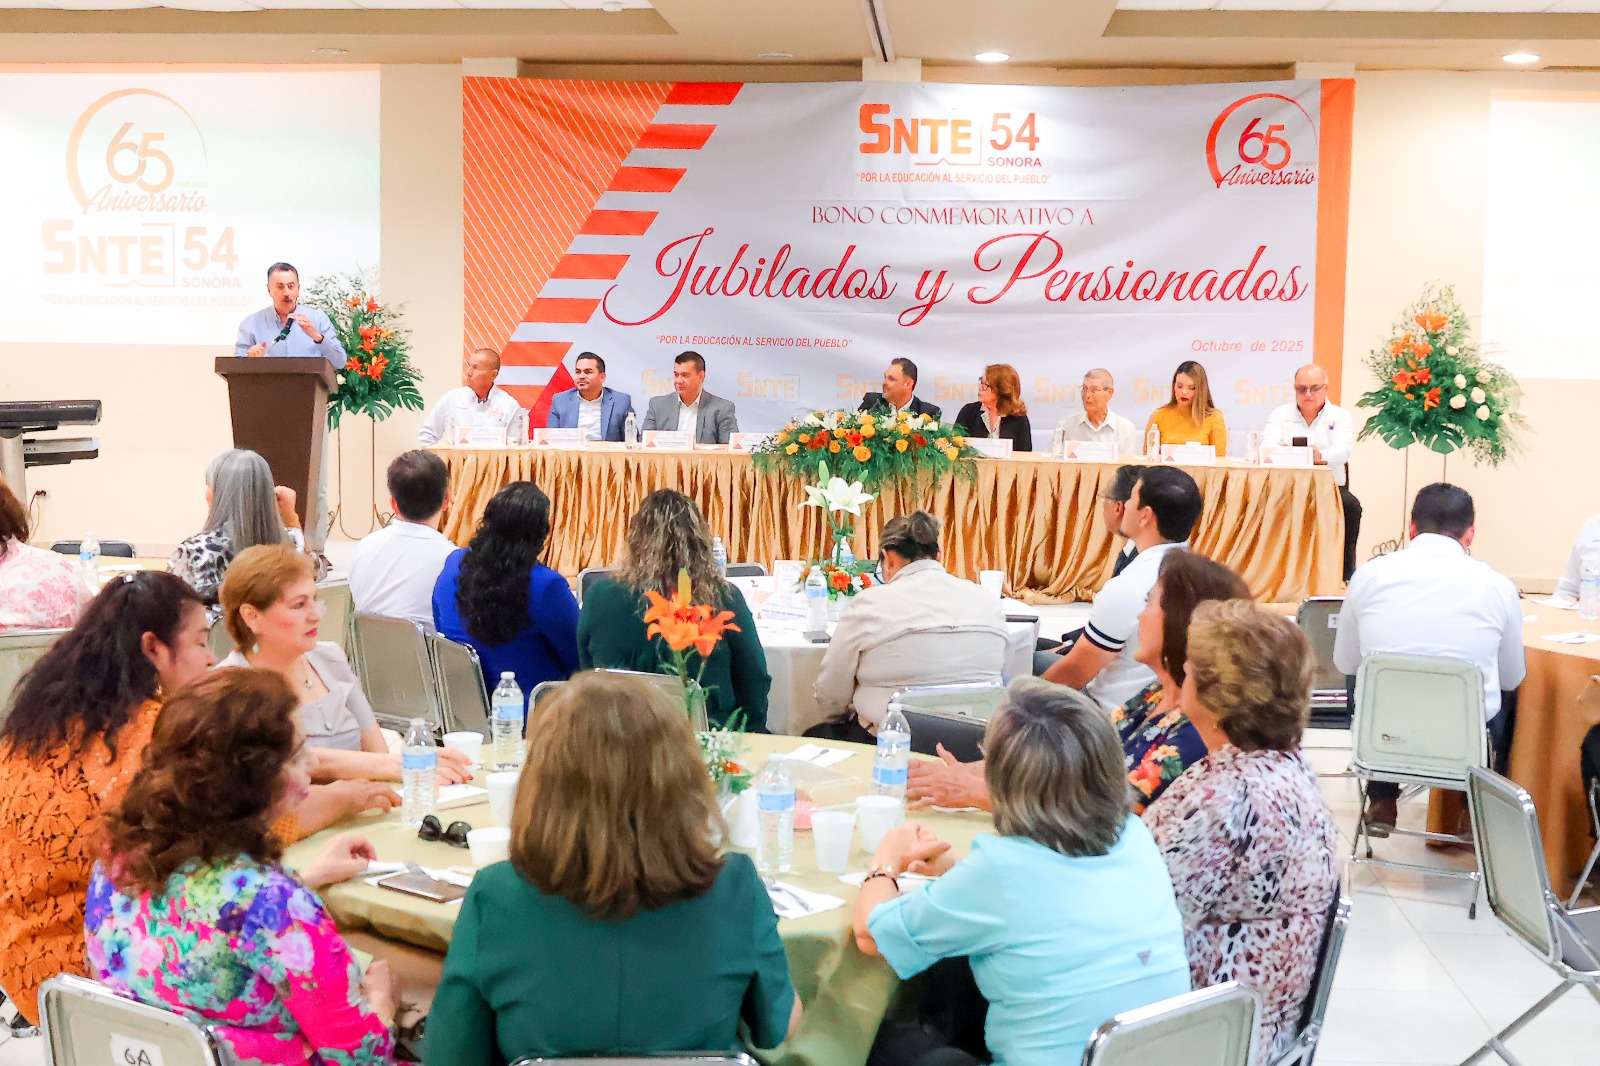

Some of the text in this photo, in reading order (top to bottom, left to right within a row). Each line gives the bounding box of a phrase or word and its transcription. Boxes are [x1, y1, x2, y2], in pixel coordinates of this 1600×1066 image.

[859, 103, 1040, 154] SNTE 54
[1238, 117, 1292, 171] 65
[106, 122, 174, 193] 65
[987, 156, 1042, 168] SONORA
[880, 172, 891, 183] LA
[892, 171, 940, 183] EDUCACIÓN
[942, 173, 953, 183] AL
[955, 173, 994, 184] SERVICIO
[995, 174, 1012, 184] DEL
[1221, 164, 1317, 186] Aniversario
[89, 183, 208, 213] Aniversario
[812, 206, 1094, 226] BONO CONMEMORATIVO A
[41, 218, 239, 277] SNTE 54
[181, 277, 242, 289] SONORA
[602, 227, 1309, 327] Jubilados y Pensionados
[66, 294, 78, 306] LA
[79, 293, 132, 307] EDUCACIÓN
[132, 295, 145, 307] AL
[146, 294, 189, 307] SERVICIO
[191, 295, 209, 307] DEL
[656, 334, 853, 349] "POR LA EDUCACIÓN AL SERVICIO DEL PUEBLO"
[1191, 339, 1305, 352] Octubre de 2025
[641, 369, 675, 395] SN
[737, 371, 796, 398] SNTE
[836, 373, 884, 400] SNT
[933, 375, 979, 401] SNT
[1034, 376, 1081, 403] SNT
